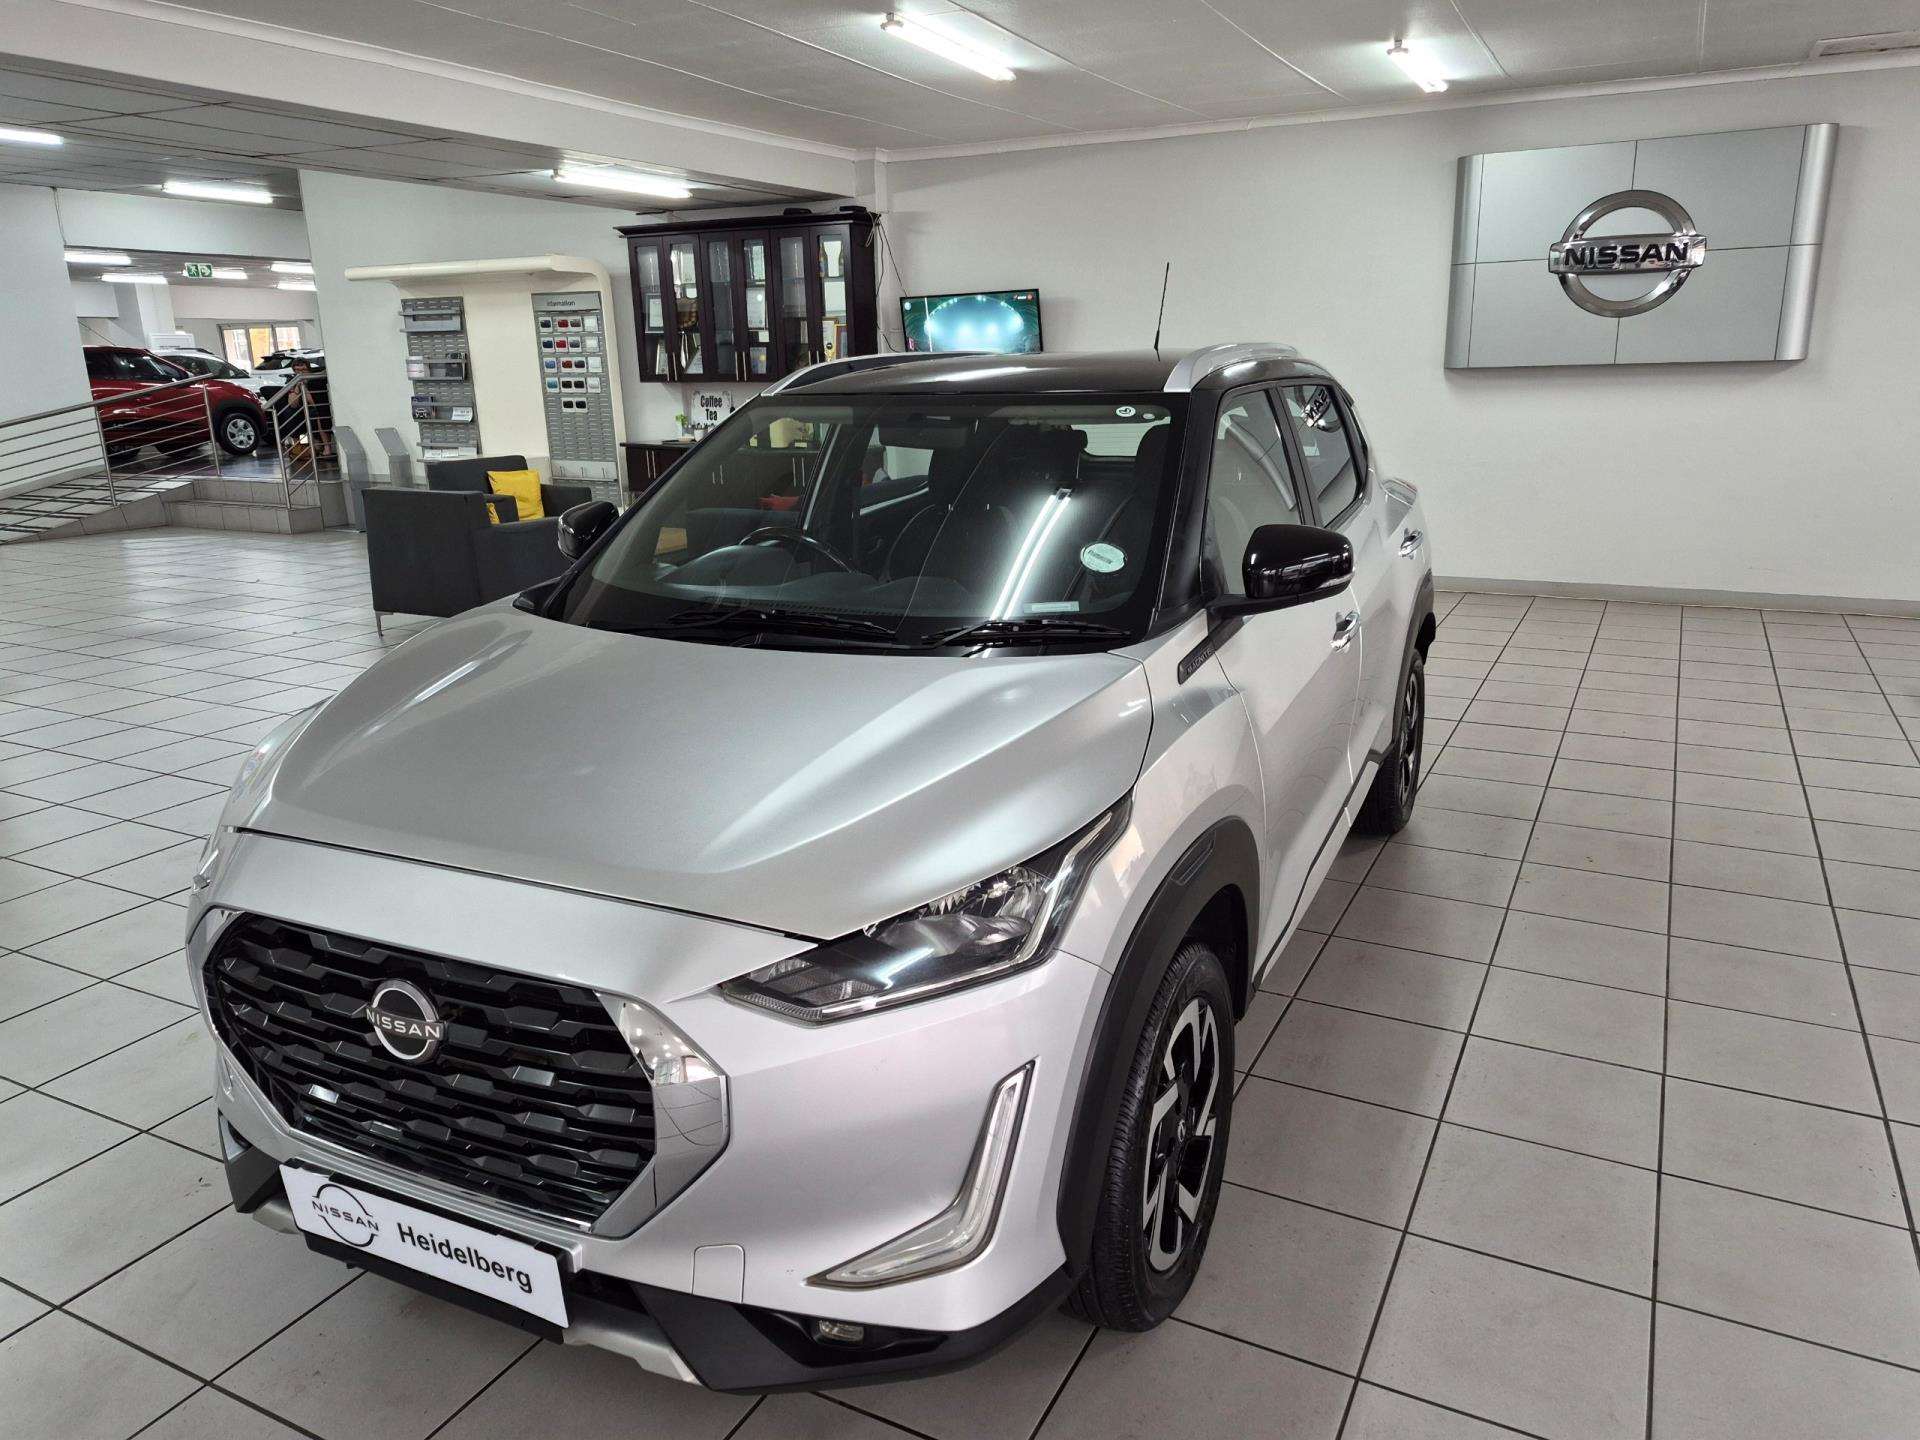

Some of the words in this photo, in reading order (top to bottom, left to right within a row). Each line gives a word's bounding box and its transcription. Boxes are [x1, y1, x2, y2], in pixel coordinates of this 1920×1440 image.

[1564, 242, 1690, 266] NISSAN
[700, 395, 722, 408] Coffee
[705, 408, 718, 421] Tea
[366, 1009, 440, 1039] NISSAN
[312, 1200, 379, 1232] NISSAN
[397, 1223, 533, 1294] Heidelberg
